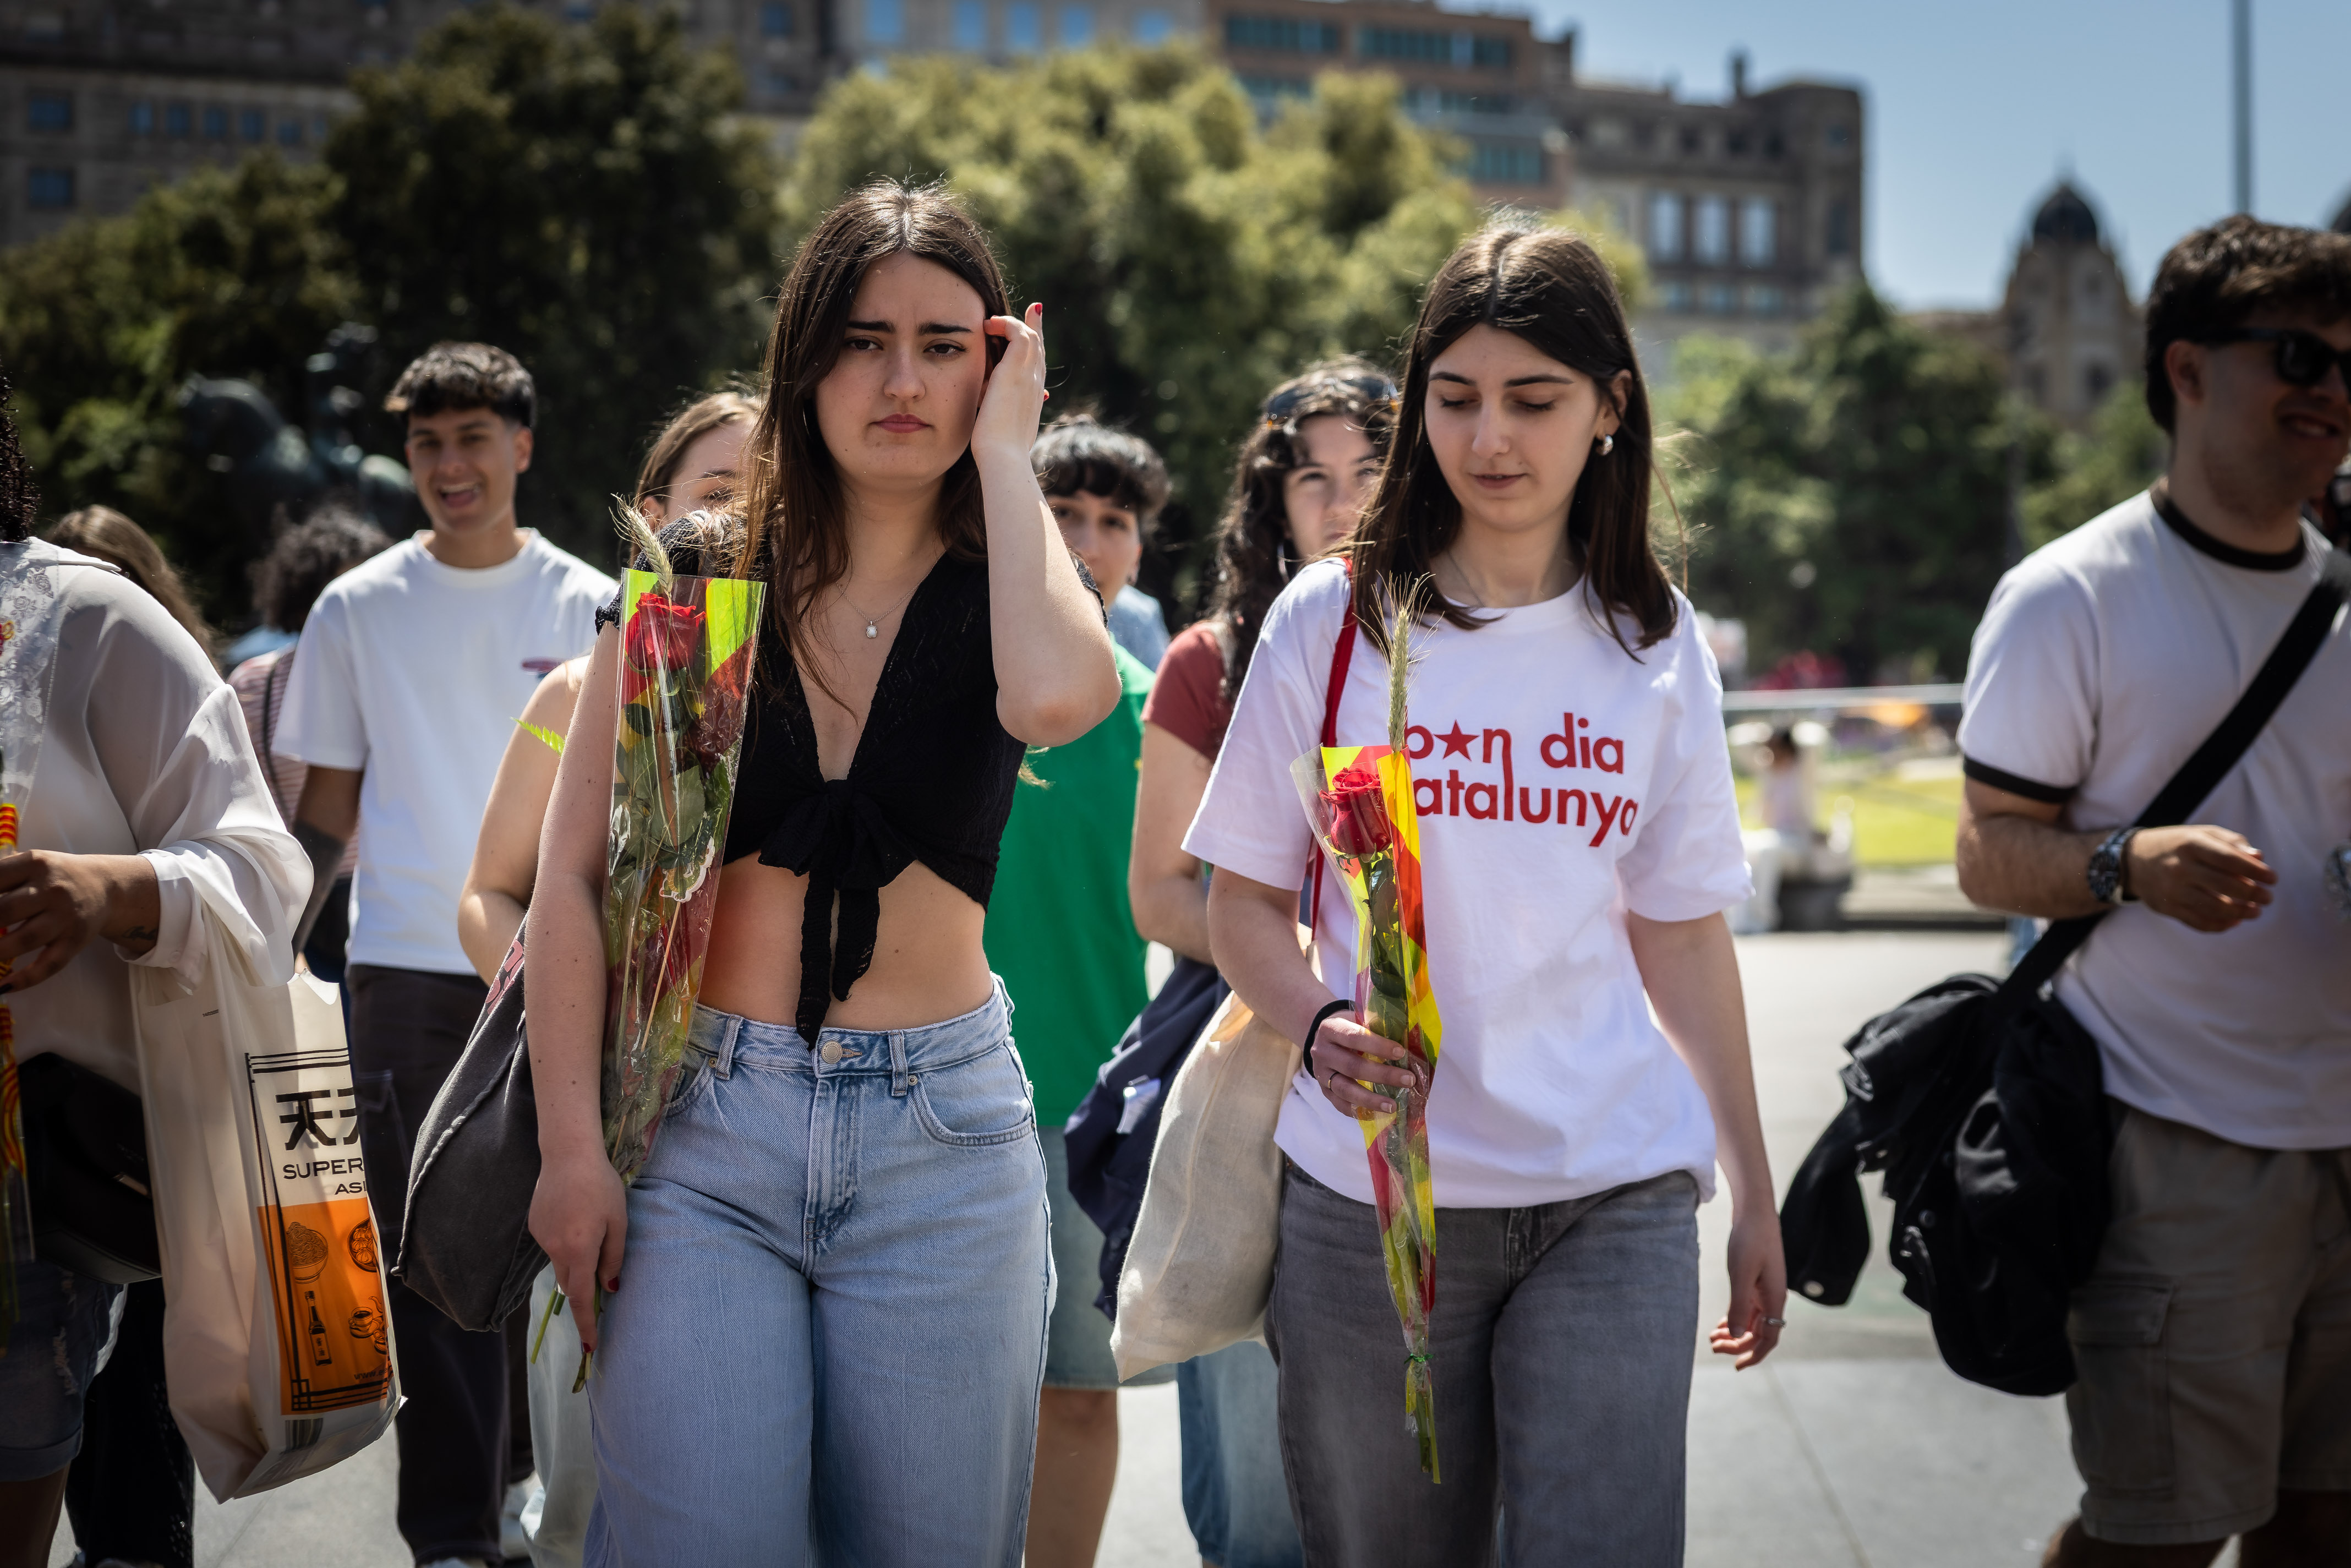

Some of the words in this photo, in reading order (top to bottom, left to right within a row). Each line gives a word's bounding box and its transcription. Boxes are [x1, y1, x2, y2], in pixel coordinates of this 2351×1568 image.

[1540, 712, 1623, 774] dia
[1413, 769, 1638, 847] atalunya
[282, 1157, 364, 1179] SUPER
